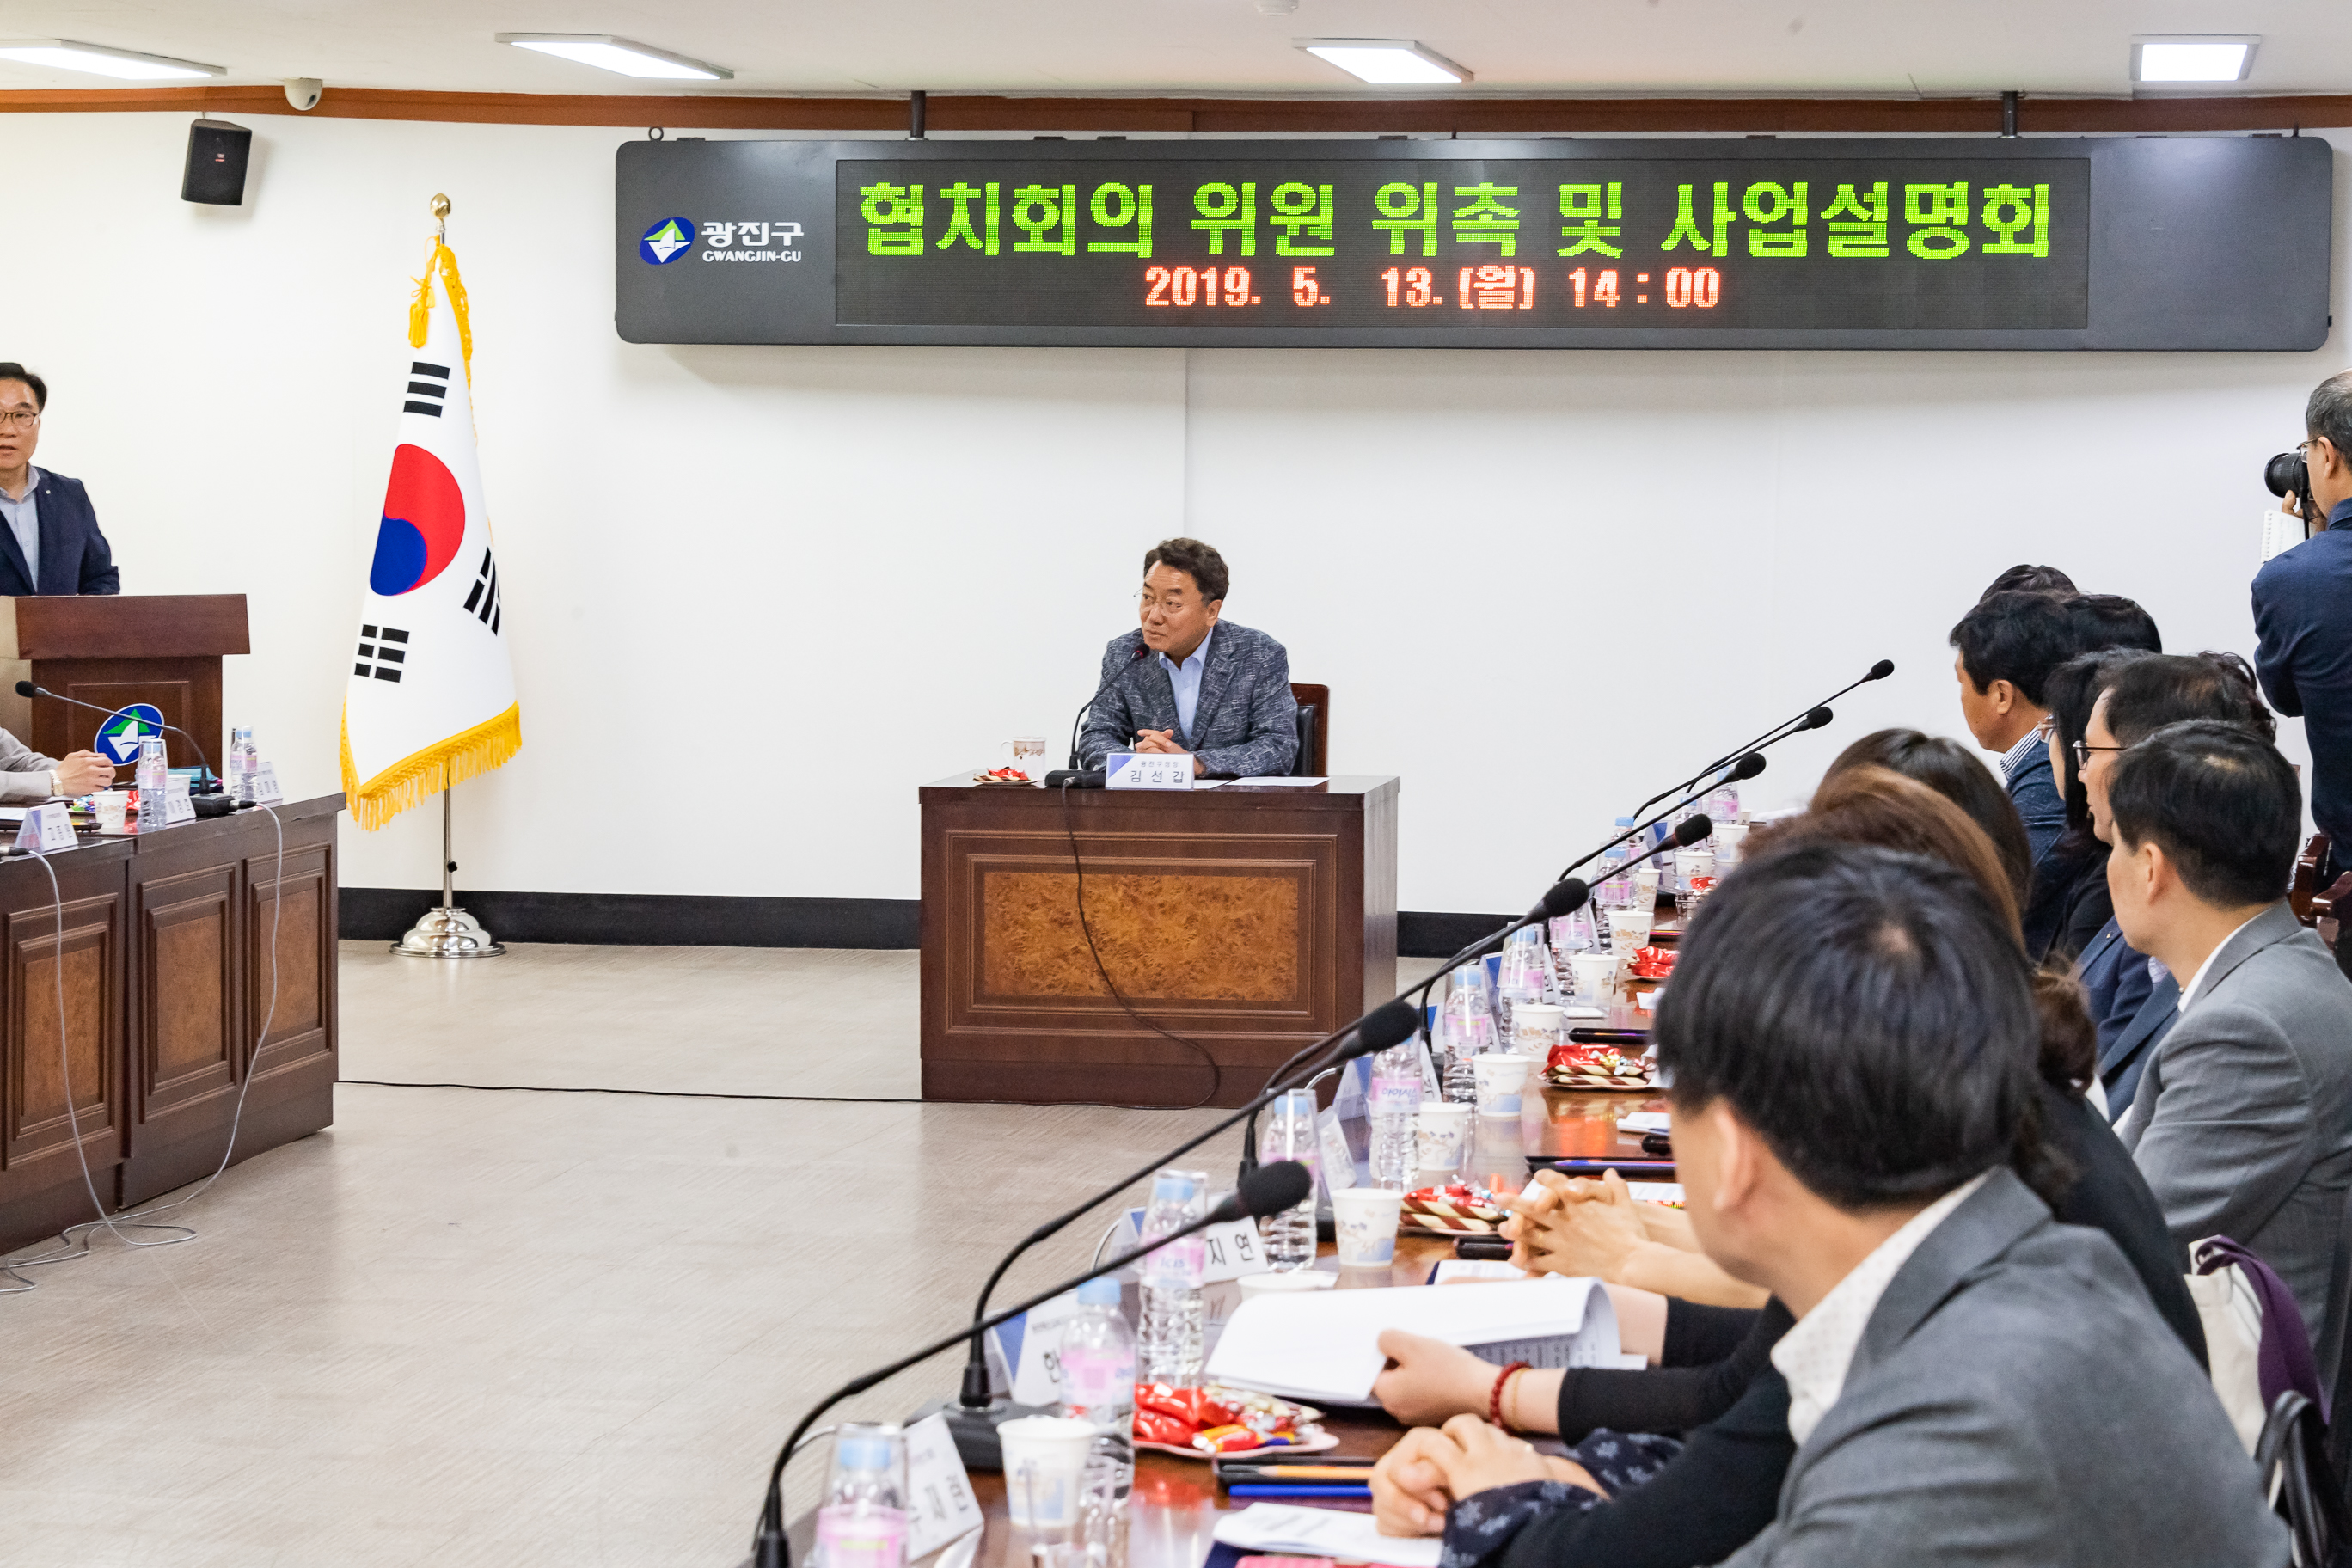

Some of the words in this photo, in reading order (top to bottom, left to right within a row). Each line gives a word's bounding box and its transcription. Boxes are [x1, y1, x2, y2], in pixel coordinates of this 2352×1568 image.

[701, 221, 805, 248] 광진구
[859, 181, 1153, 258] 협치회의
[1190, 181, 1335, 257] 위원
[1371, 181, 1521, 257] 위촉
[1556, 181, 1623, 259] 및
[1660, 181, 2049, 260] 사업설명회
[702, 250, 802, 262] GWANGJIN-GU
[1144, 266, 1261, 307] 2019.
[1291, 266, 1331, 307] 5.
